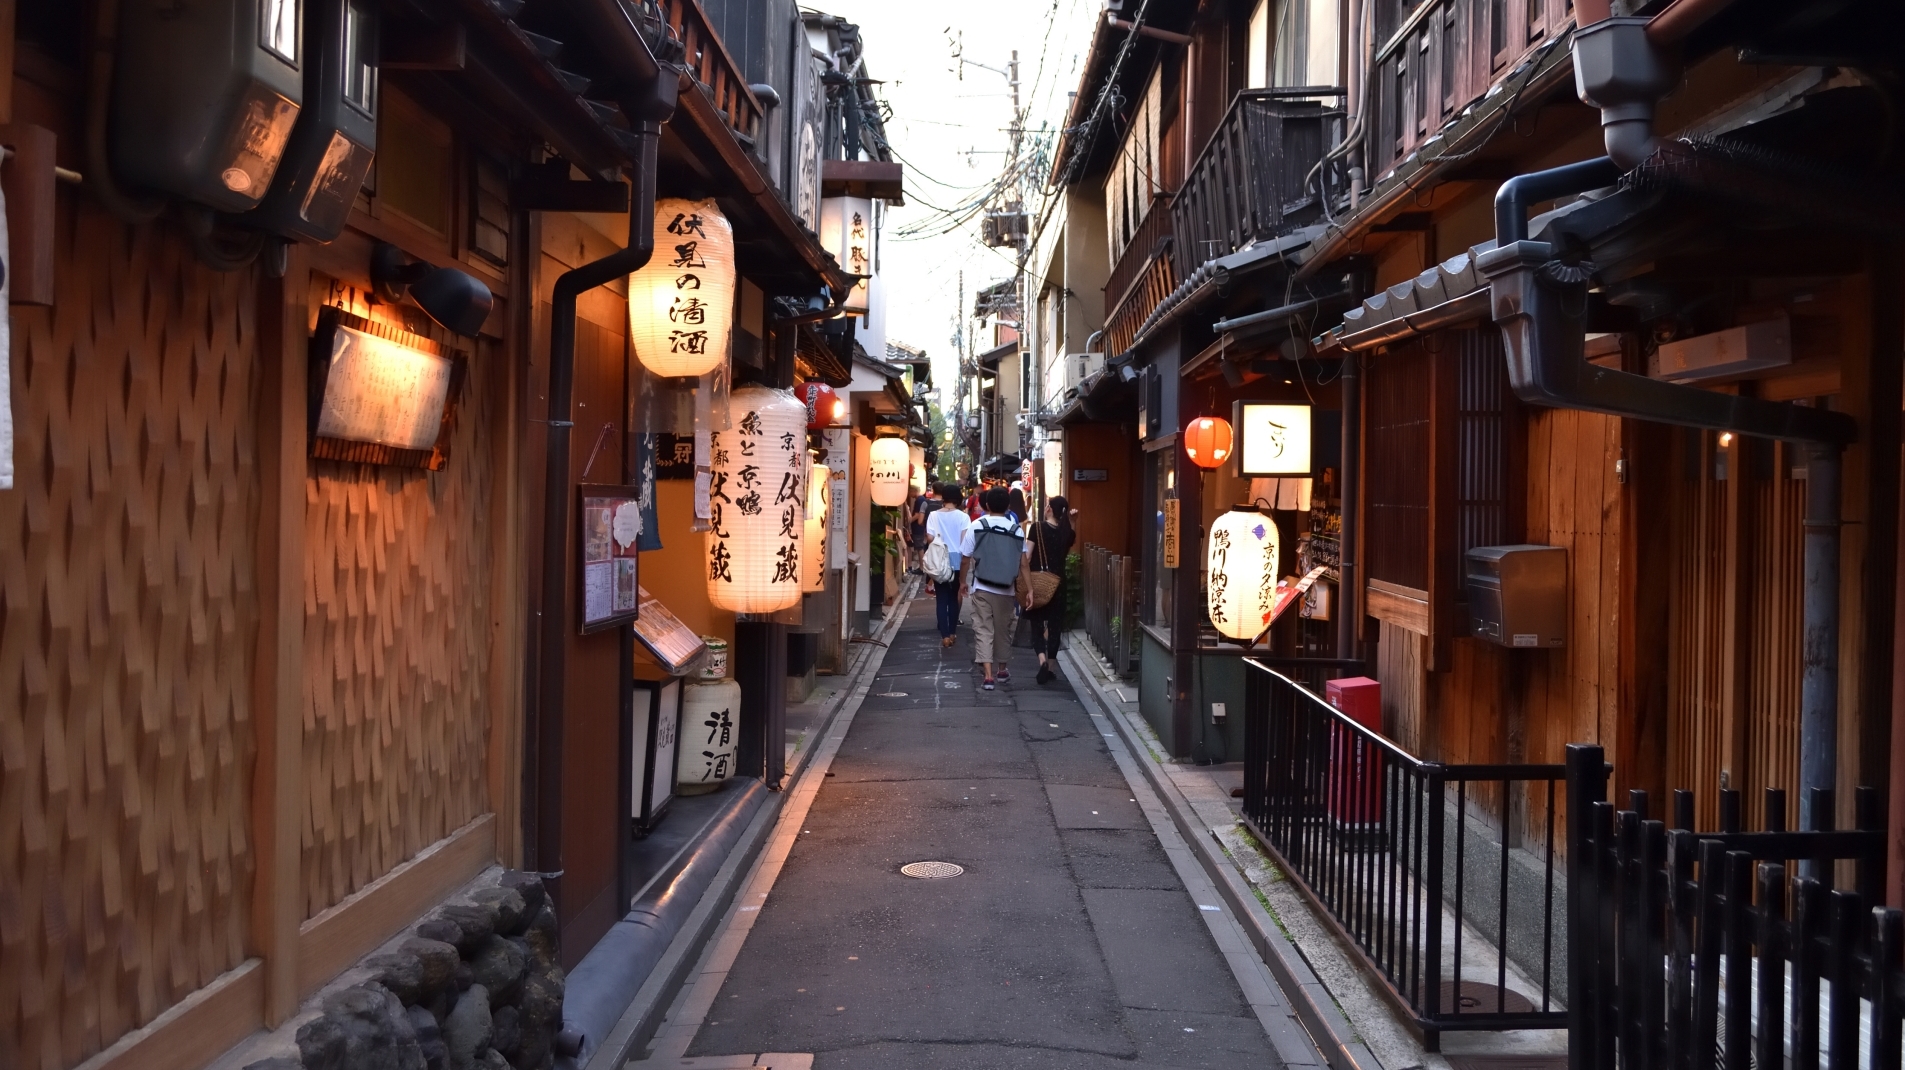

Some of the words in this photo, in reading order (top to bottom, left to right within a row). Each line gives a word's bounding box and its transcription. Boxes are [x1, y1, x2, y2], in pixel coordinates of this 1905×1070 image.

[667, 213, 708, 355] 伏見の清酒
[735, 410, 763, 517] 魚と京鴨
[1257, 542, 1276, 612] 京の夕涼み
[701, 708, 733, 782] 清酒
